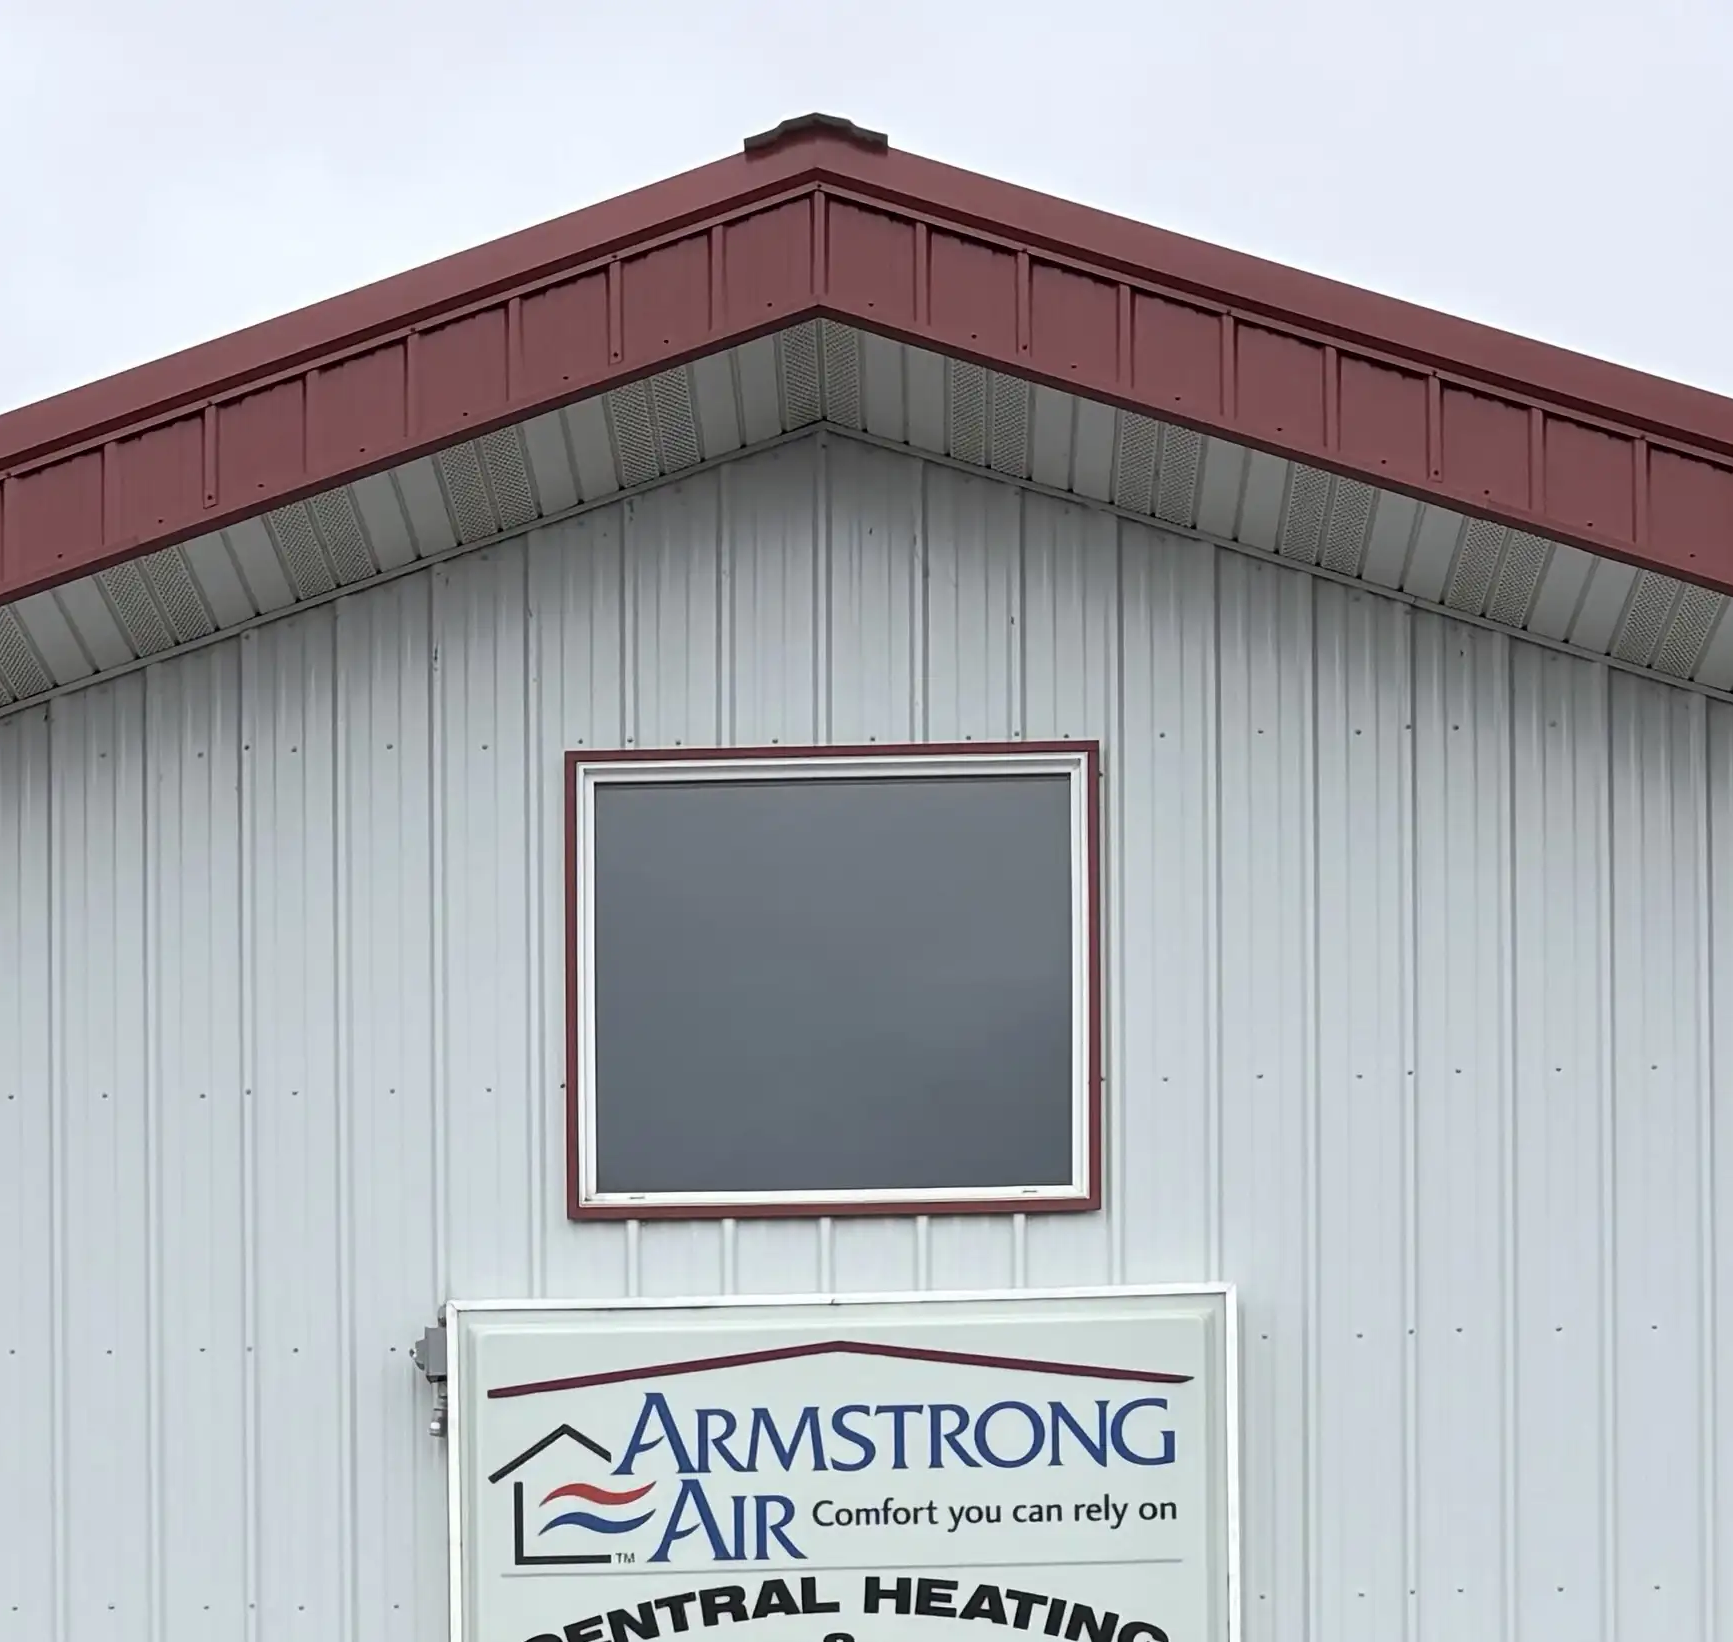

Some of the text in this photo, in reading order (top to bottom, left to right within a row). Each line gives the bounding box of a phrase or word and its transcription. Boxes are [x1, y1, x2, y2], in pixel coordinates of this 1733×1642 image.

[614, 1393, 1175, 1475] ARMSTRONG
[646, 1479, 807, 1562] AIR
[813, 1494, 1176, 1532] Comfort you can rely on
